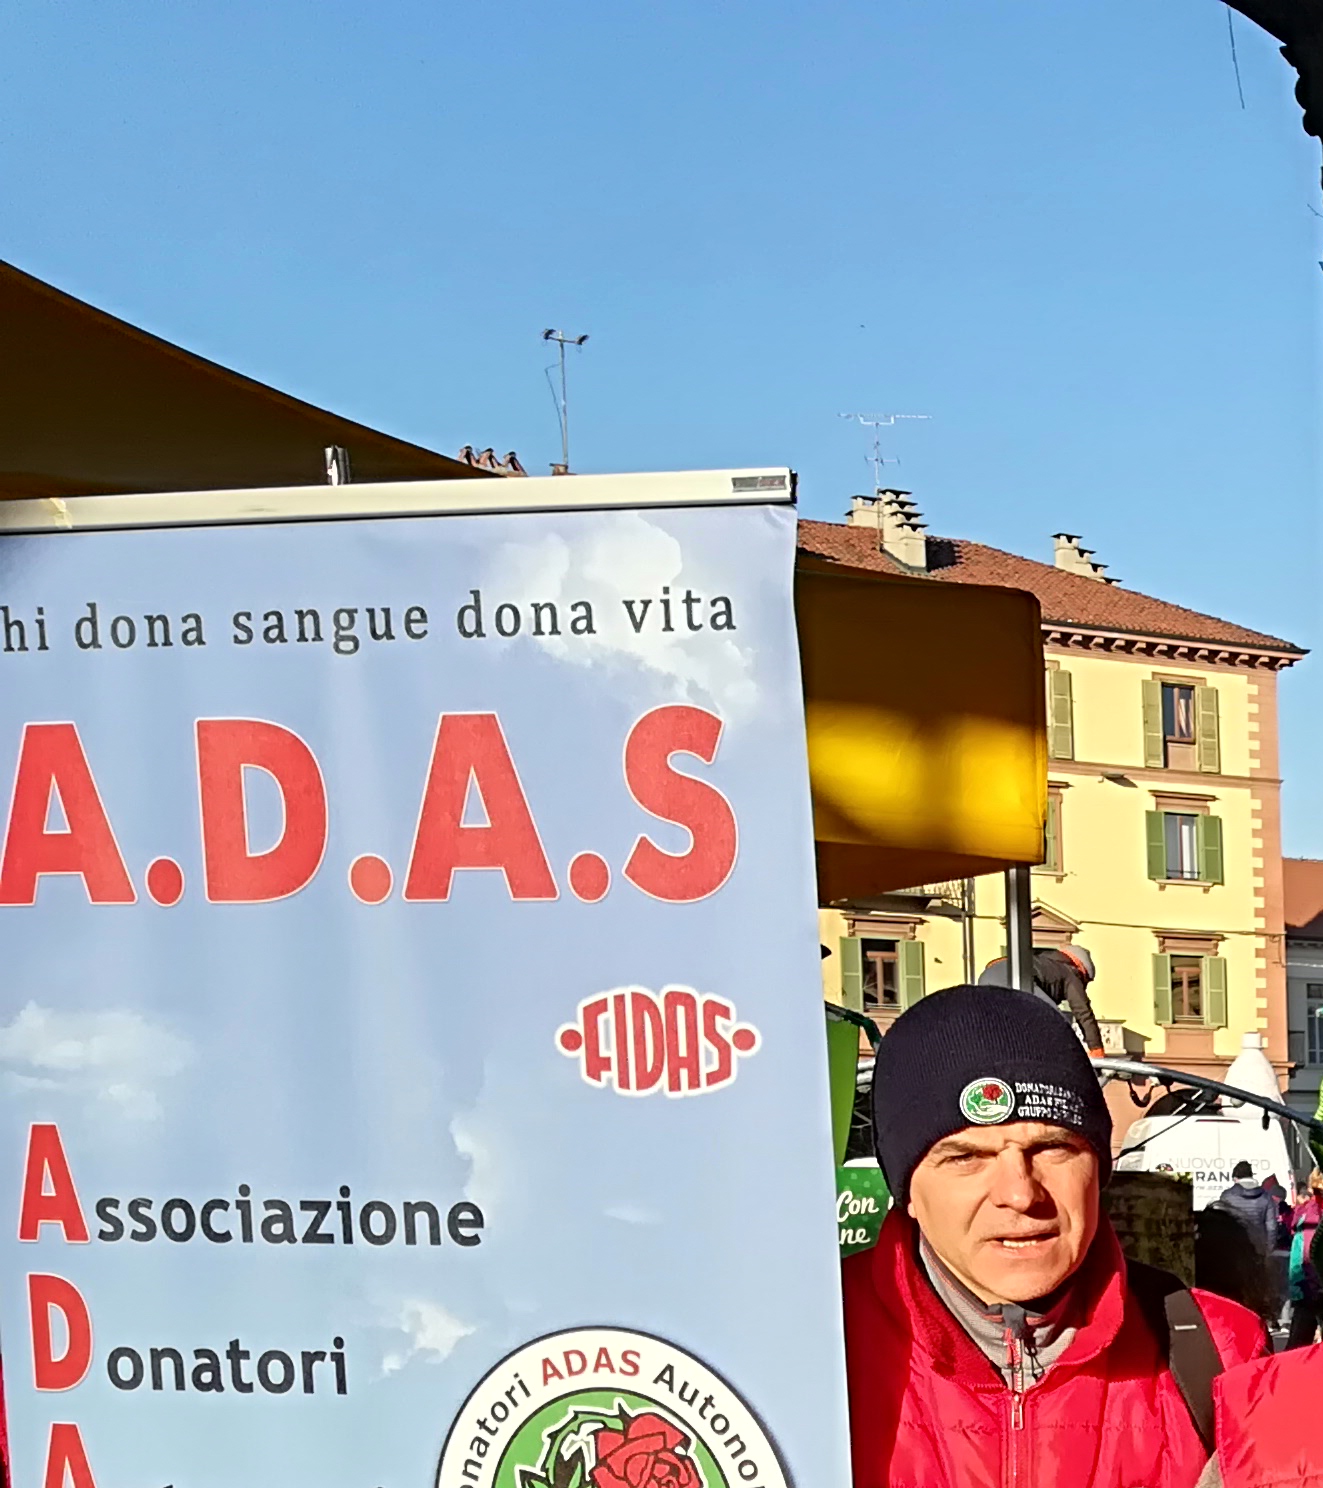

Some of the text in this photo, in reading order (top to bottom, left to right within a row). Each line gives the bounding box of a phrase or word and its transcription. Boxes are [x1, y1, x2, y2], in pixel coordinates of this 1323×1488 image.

[0, 586, 737, 655] hi dona sangue dona vita
[0, 705, 739, 906] A.D.A.S
[582, 988, 734, 1094] FIDAS
[836, 1190, 879, 1222] Con
[540, 1346, 642, 1387] ADAS
